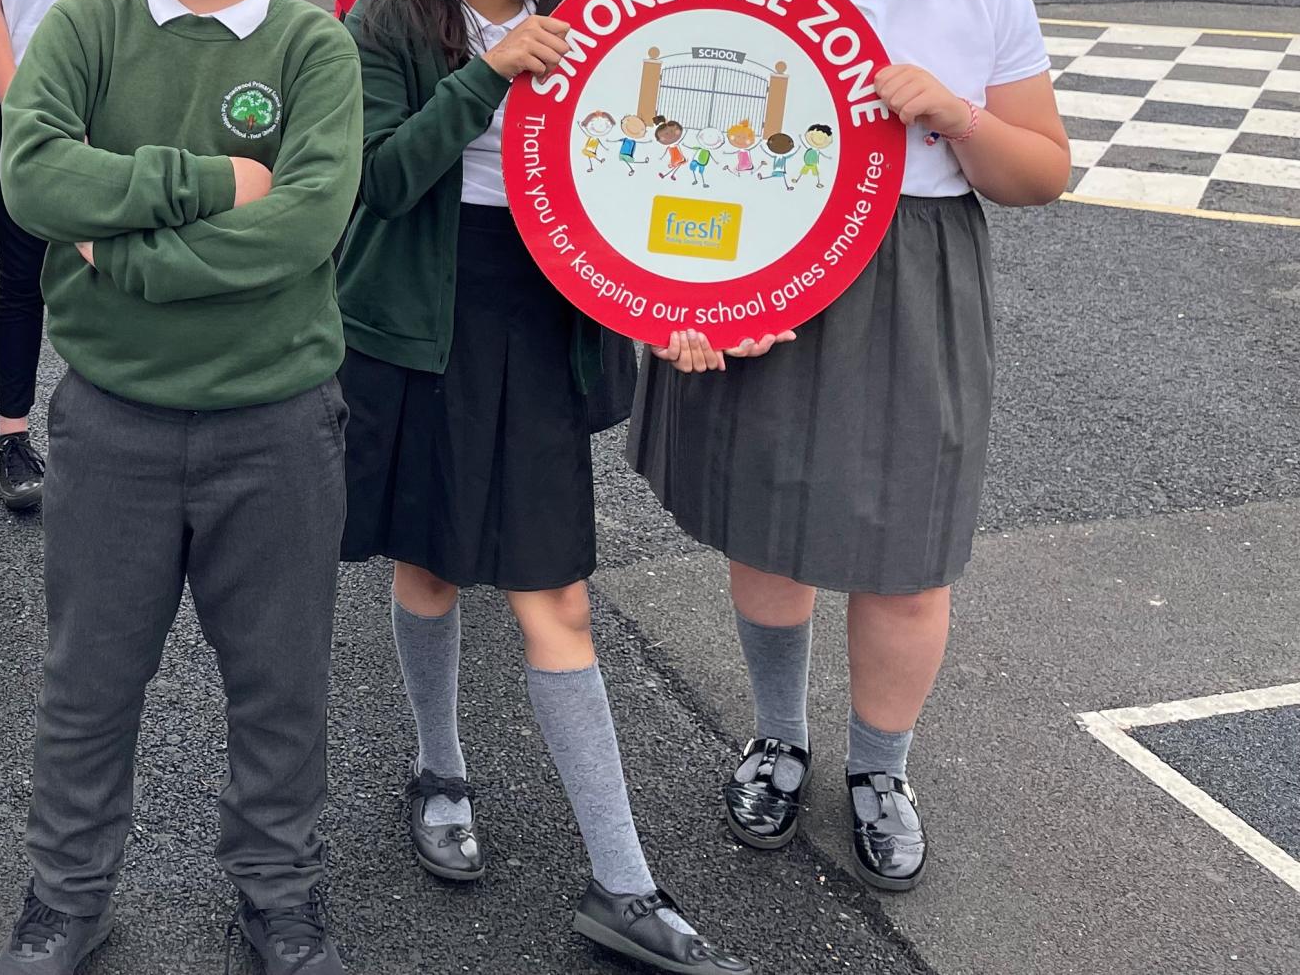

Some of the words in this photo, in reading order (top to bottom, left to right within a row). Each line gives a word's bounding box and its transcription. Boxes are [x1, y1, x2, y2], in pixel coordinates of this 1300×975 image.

[698, 49, 739, 62] SCHOOL
[523, 112, 545, 179] Thank
[856, 150, 885, 196] free
[525, 184, 556, 224] you
[548, 226, 573, 255] for
[666, 212, 722, 240] fresh
[824, 200, 873, 266] smoke
[570, 253, 647, 317] keeping
[772, 263, 826, 311] gates
[653, 302, 689, 323] our
[695, 292, 766, 325] school
